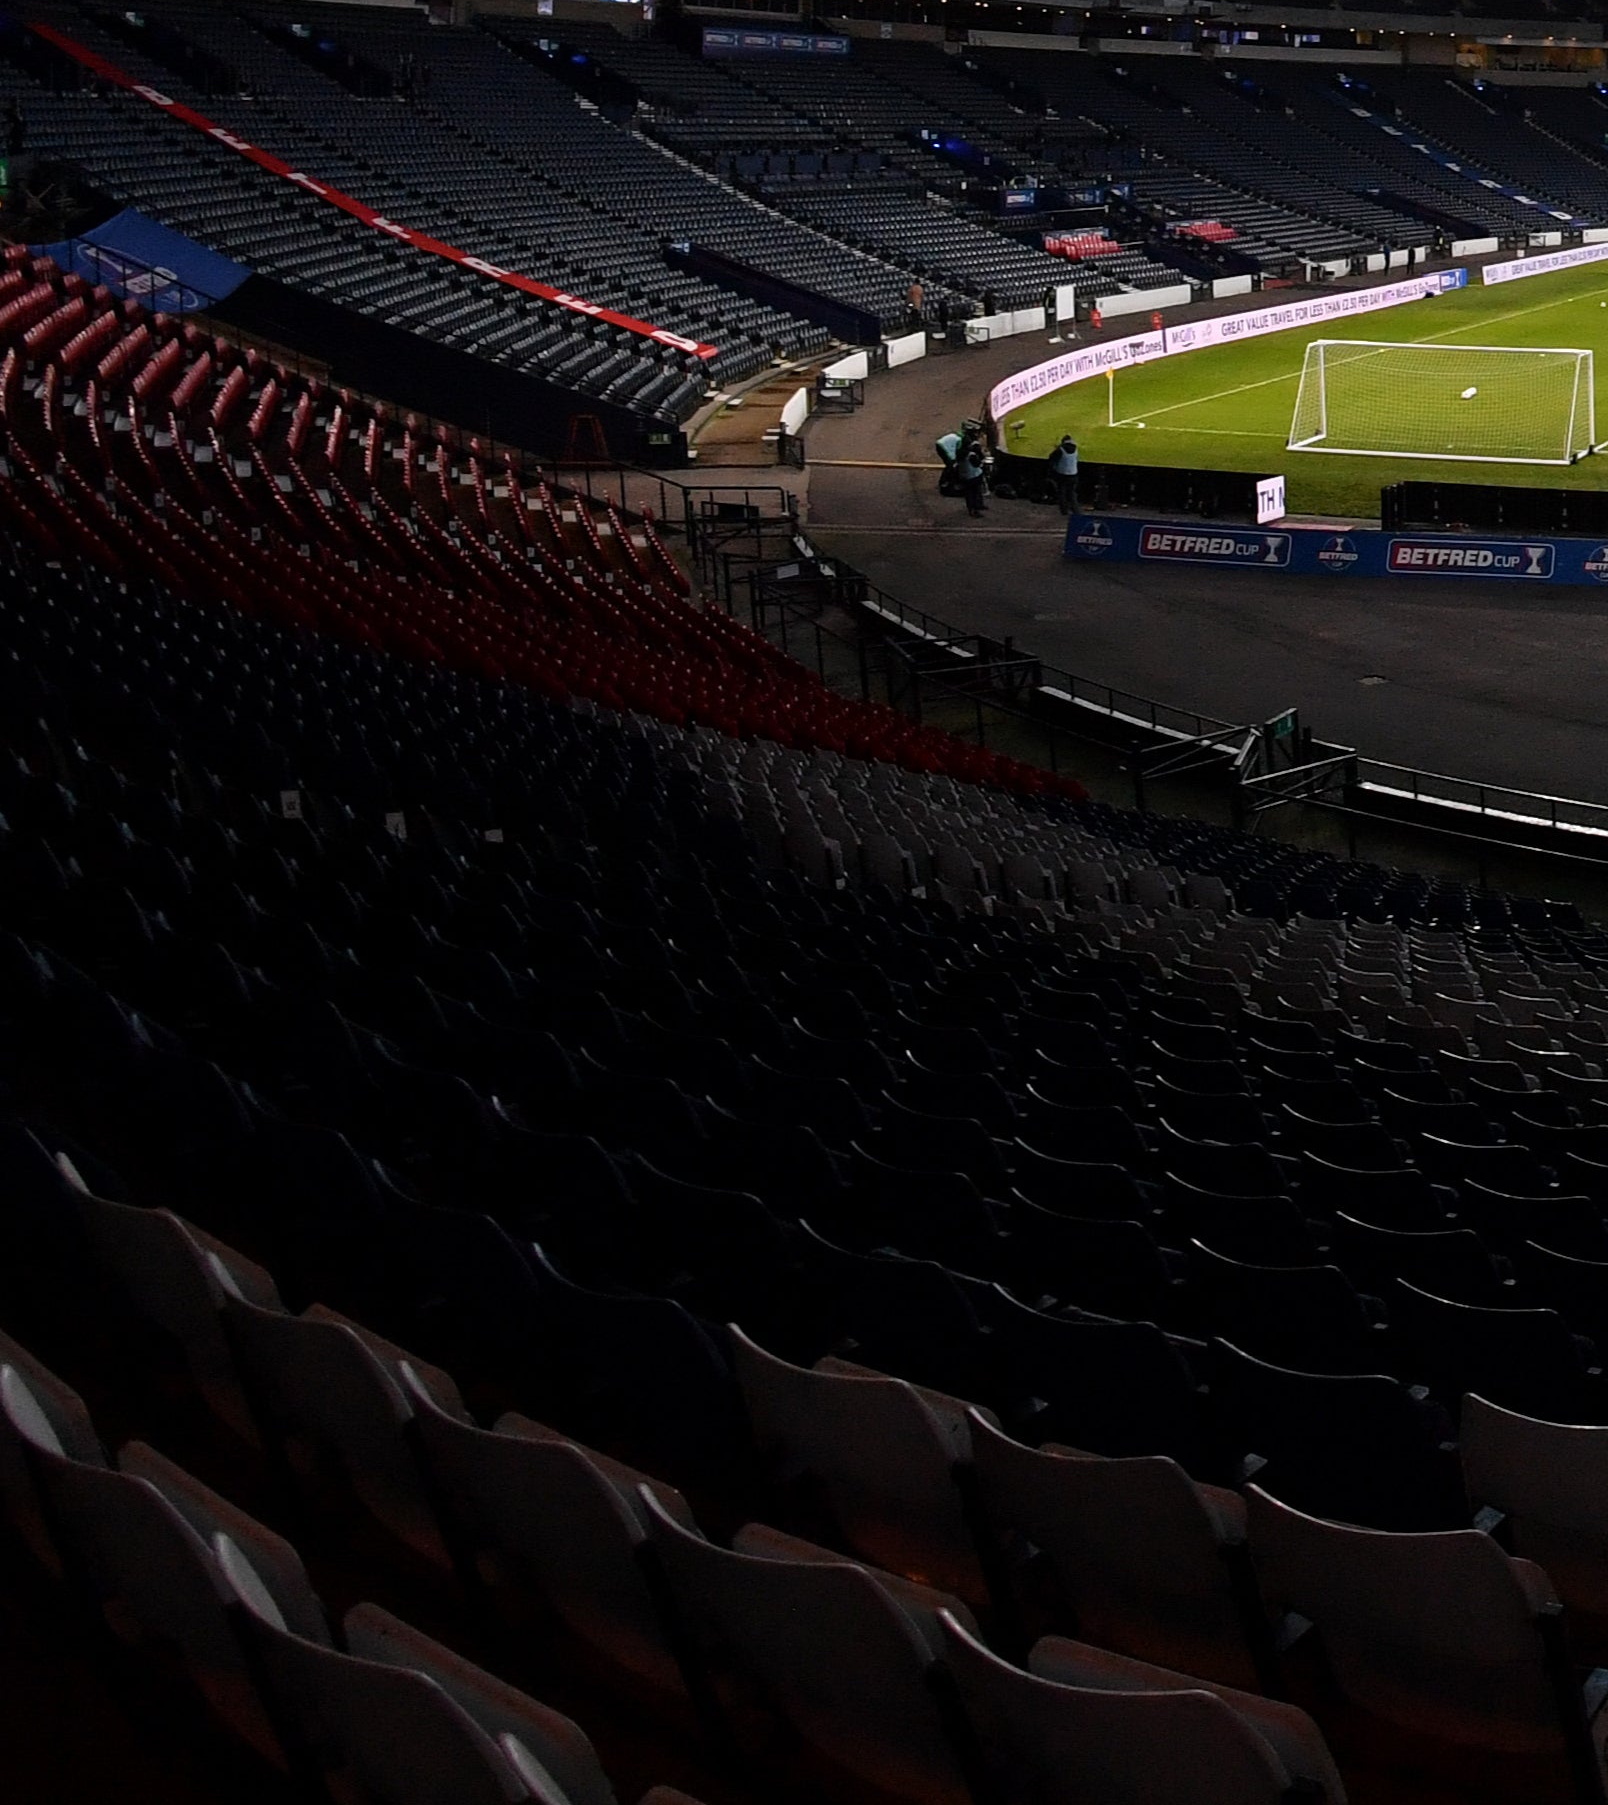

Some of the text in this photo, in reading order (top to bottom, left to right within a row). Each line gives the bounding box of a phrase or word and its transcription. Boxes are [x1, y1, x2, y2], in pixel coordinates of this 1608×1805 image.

[1222, 319, 1244, 336] GREAT
[1247, 314, 1269, 330] VALUE
[1270, 310, 1294, 325] TRAVEL
[1295, 306, 1308, 320] FOR
[1310, 303, 1323, 317] LESS
[1324, 300, 1340, 314] THAN
[1011, 378, 1030, 400] THAN
[1047, 365, 1059, 385] PER
[1060, 360, 1074, 380] DAY
[1075, 354, 1094, 373] WITH
[1147, 534, 1259, 556] BETFRED CUP
[1318, 552, 1358, 562] BETFRED
[1395, 547, 1519, 568] BETFRED CUP
